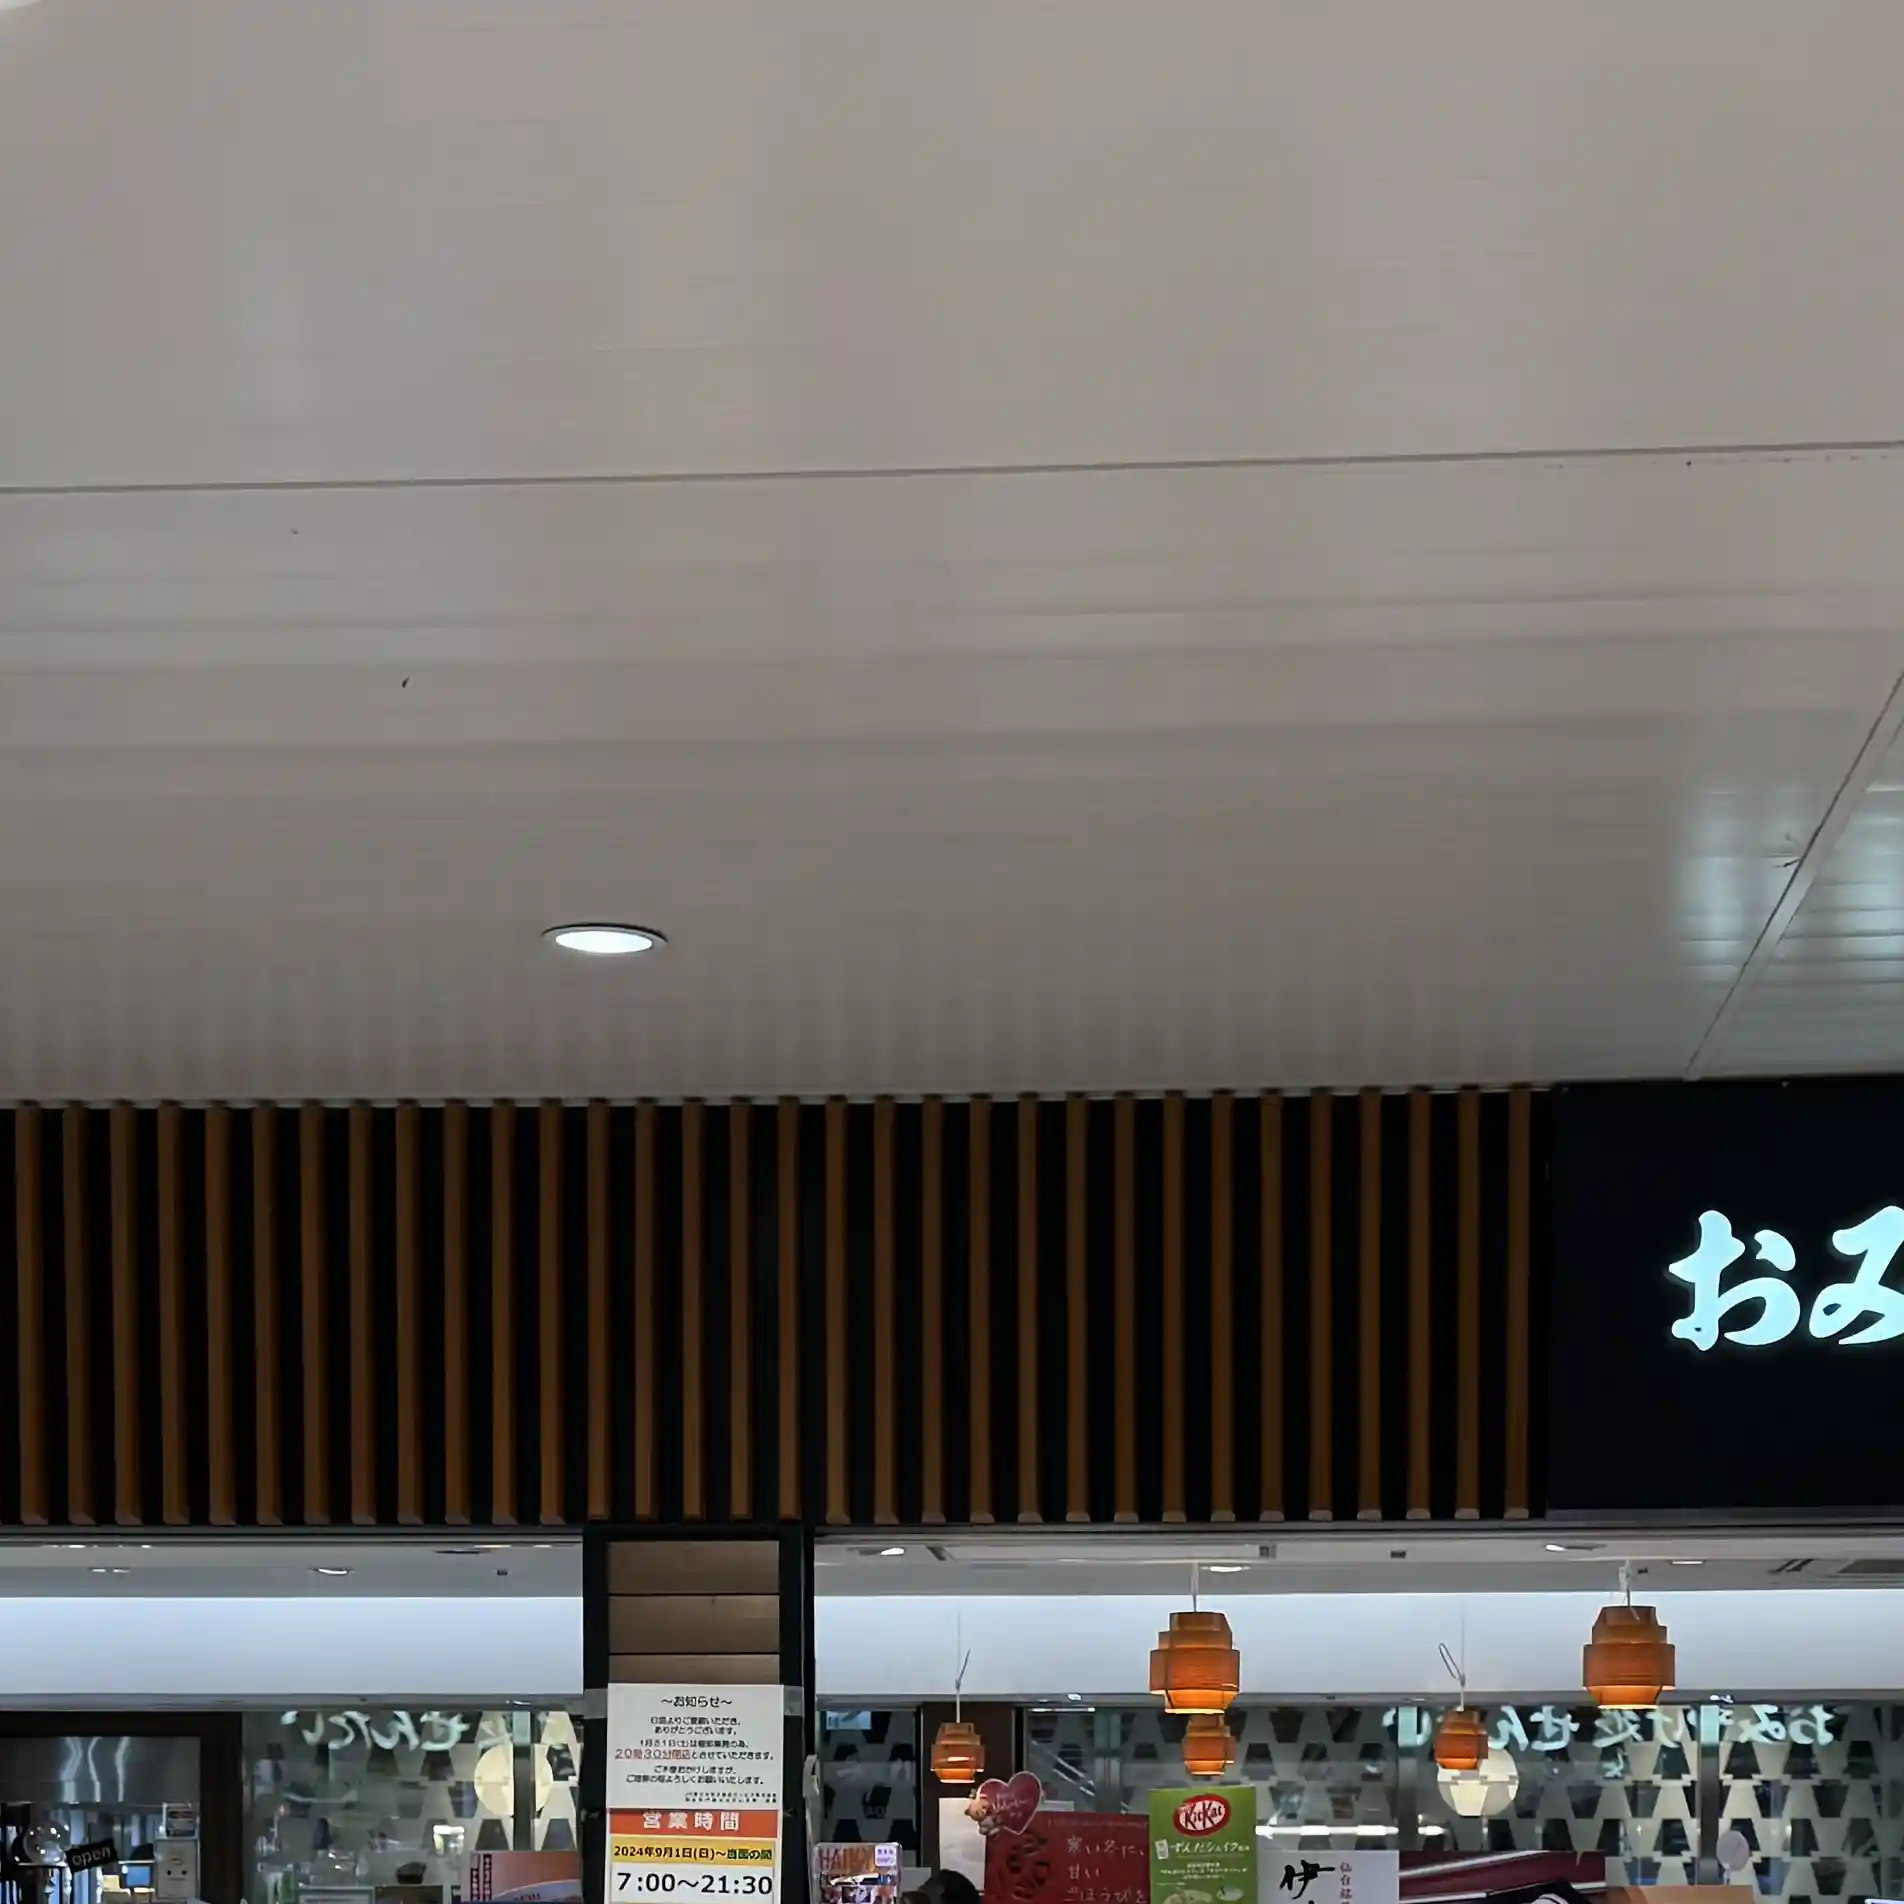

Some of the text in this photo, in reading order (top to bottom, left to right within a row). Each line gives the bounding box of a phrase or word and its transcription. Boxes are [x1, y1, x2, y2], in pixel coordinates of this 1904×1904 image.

[642, 1811, 740, 1831] 営業時間
[1179, 1799, 1228, 1833] KitKat
[1067, 1864, 1101, 1880] 甘い
